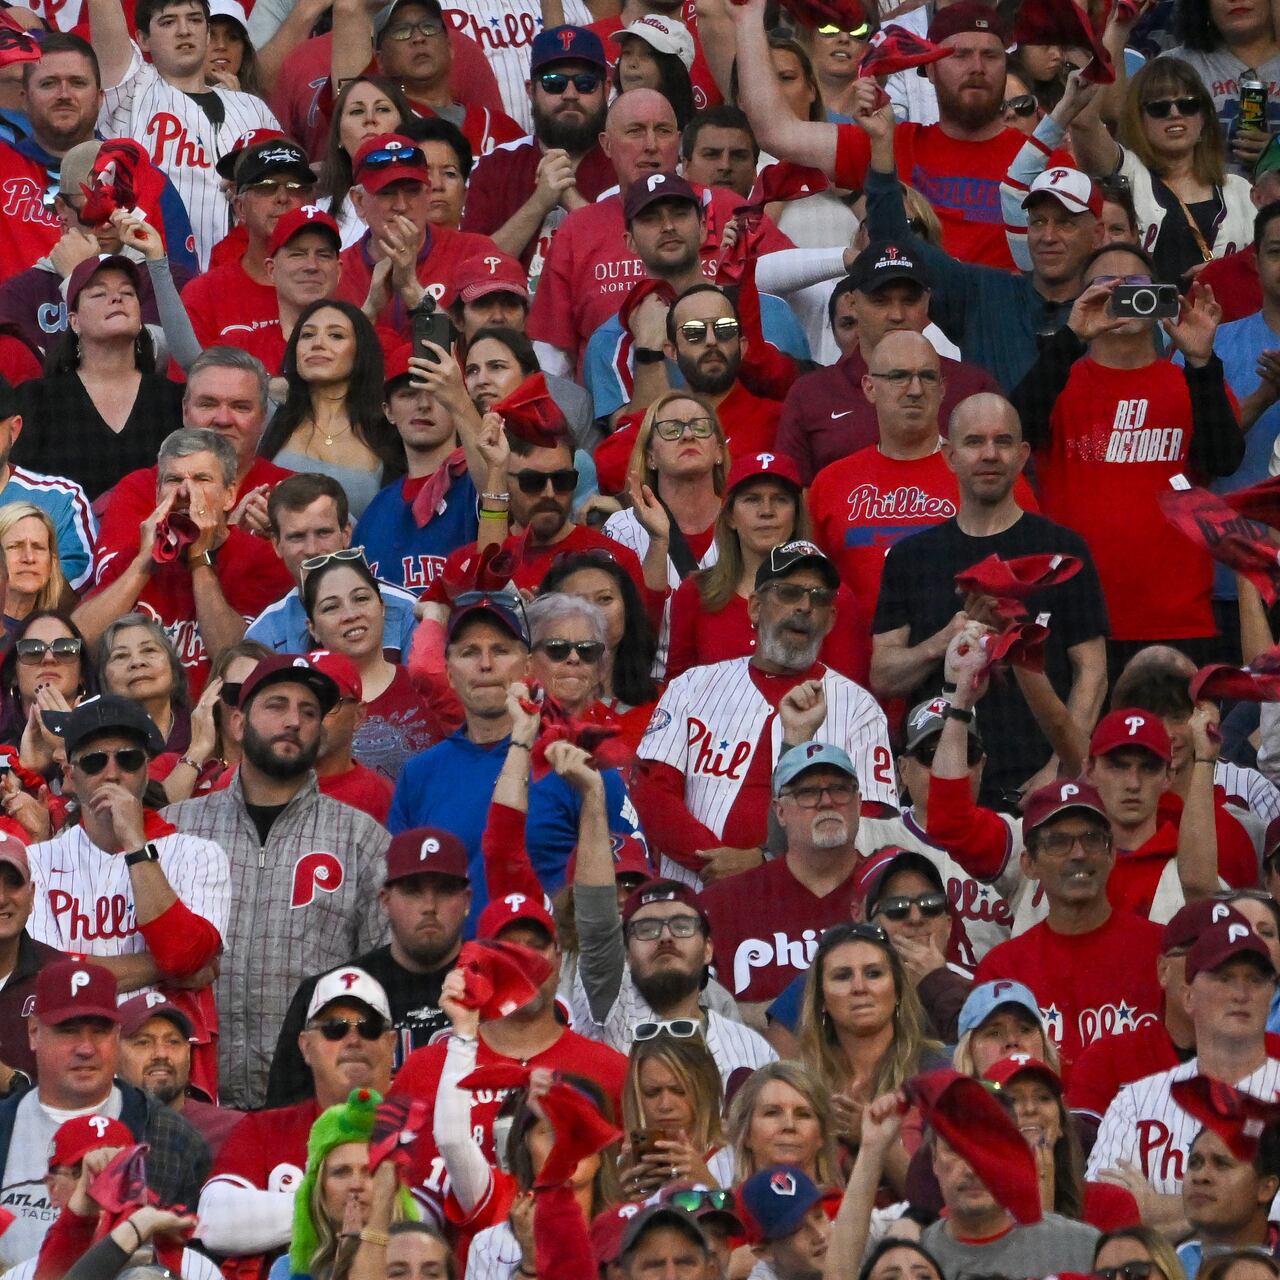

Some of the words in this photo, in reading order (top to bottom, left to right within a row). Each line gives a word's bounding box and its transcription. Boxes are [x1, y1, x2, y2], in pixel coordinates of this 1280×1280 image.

[595, 260, 638, 279] OUTE
[599, 281, 635, 295] NORT
[1113, 399, 1149, 429] RED
[1104, 428, 1183, 463] OCTOBER
[847, 486, 957, 520] Phillies
